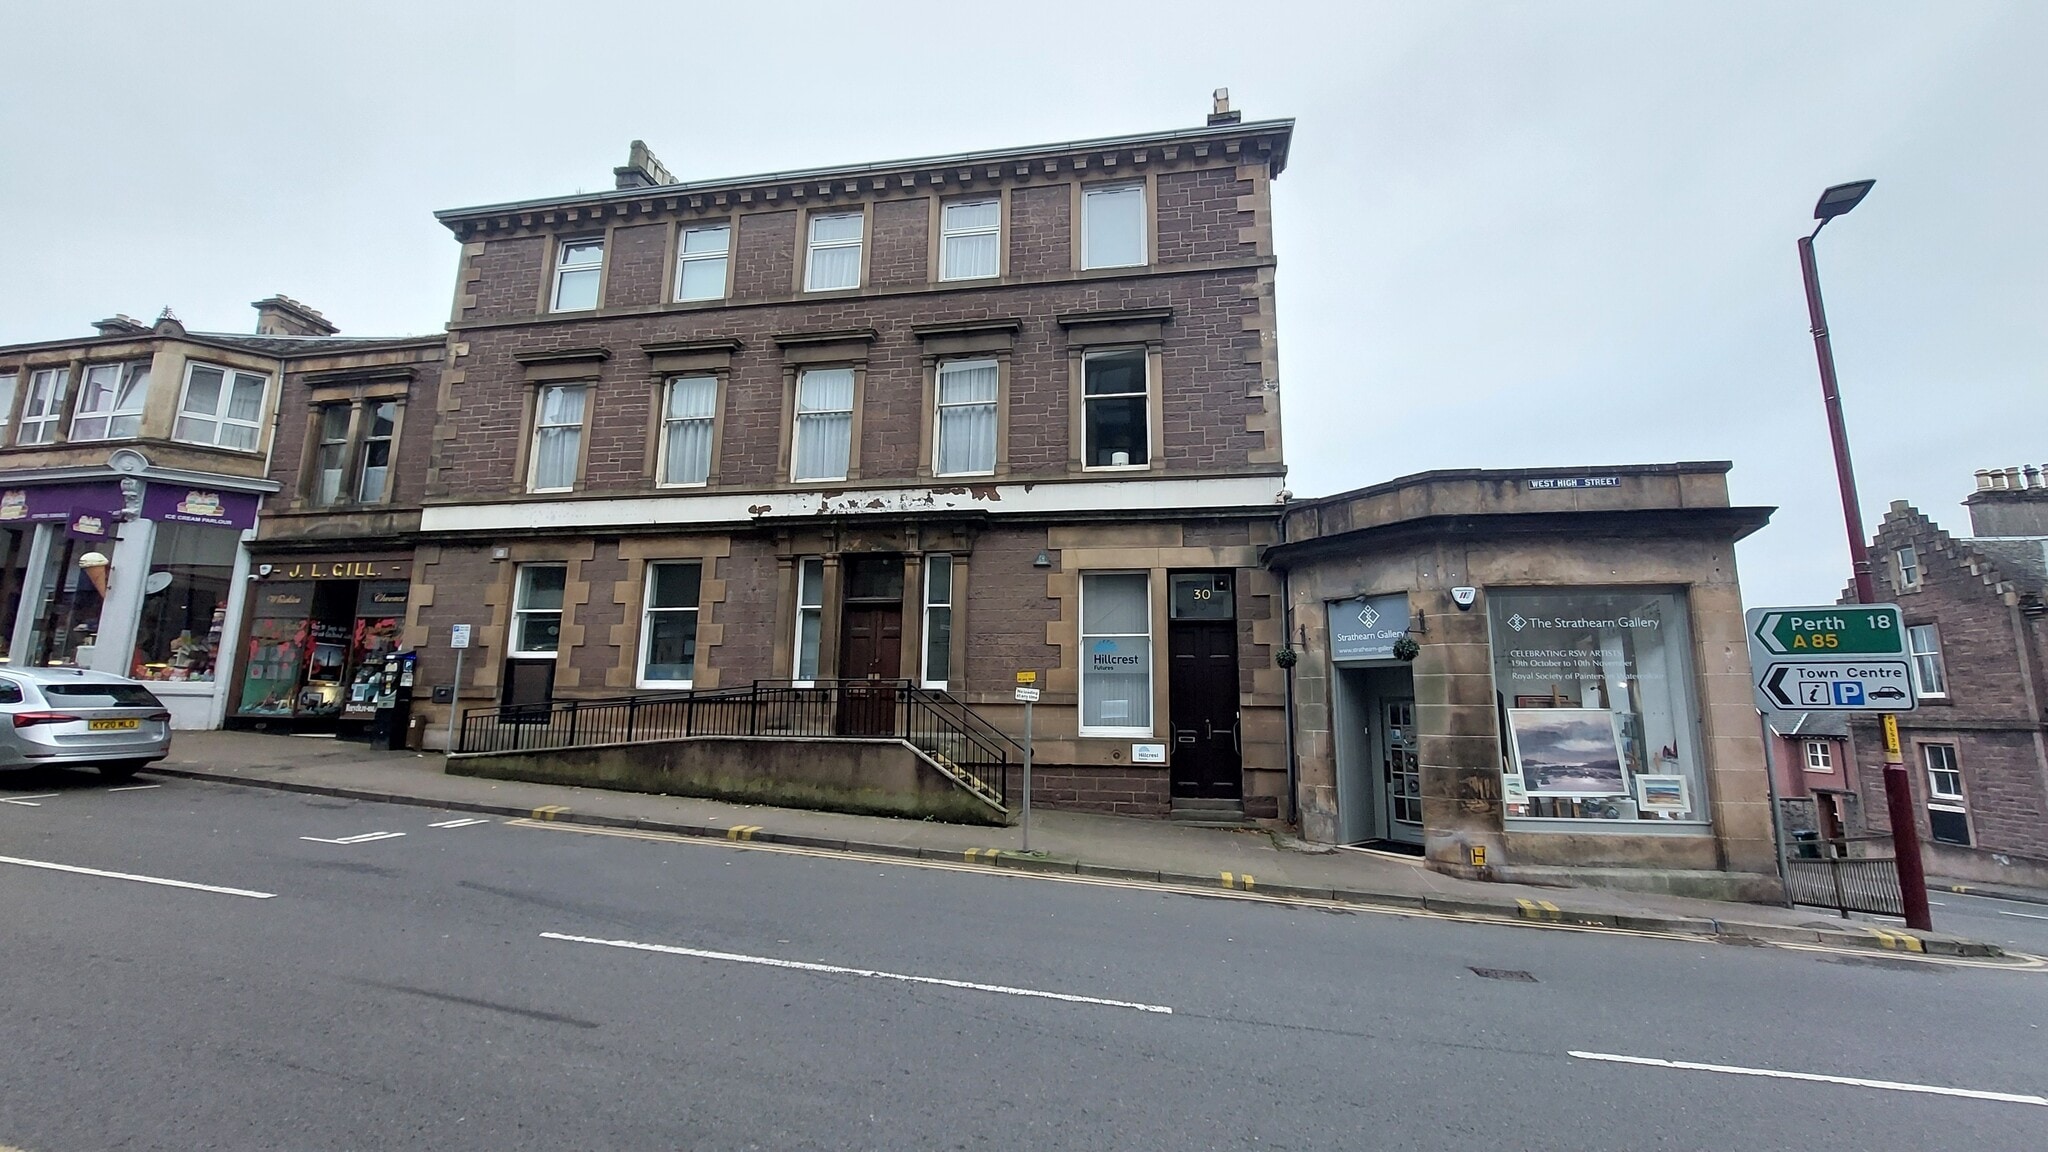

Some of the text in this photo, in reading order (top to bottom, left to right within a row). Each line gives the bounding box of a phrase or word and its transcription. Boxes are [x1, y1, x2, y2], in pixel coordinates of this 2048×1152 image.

[1531, 477, 1617, 488] WEST HIGH STREET
[202, 516, 233, 525] PARLOUR
[289, 564, 303, 578] J.
[311, 564, 327, 577] L.
[1193, 589, 1211, 600] 30
[1528, 617, 1660, 630] The Strathearn Gallery
[1790, 615, 1891, 631] Perth 18
[1337, 630, 1405, 642] Strathearn Gallery
[1793, 634, 1839, 648] A 85
[1510, 649, 1623, 658] CELEBRATING RSW ARTISTS
[1093, 654, 1139, 665] Hillcrest
[1511, 659, 1528, 667] 19th
[1530, 659, 1561, 667] October
[1573, 659, 1590, 667] 10th
[1593, 659, 1632, 667] November
[1512, 672, 1534, 681] Royal
[1535, 672, 1562, 681] Society
[1564, 672, 1572, 680] of
[1574, 672, 1605, 680] Painters
[1796, 667, 1902, 678] Town Centre
[1839, 683, 1860, 704] P
[92, 721, 116, 729] KY20
[1472, 848, 1485, 864] H
